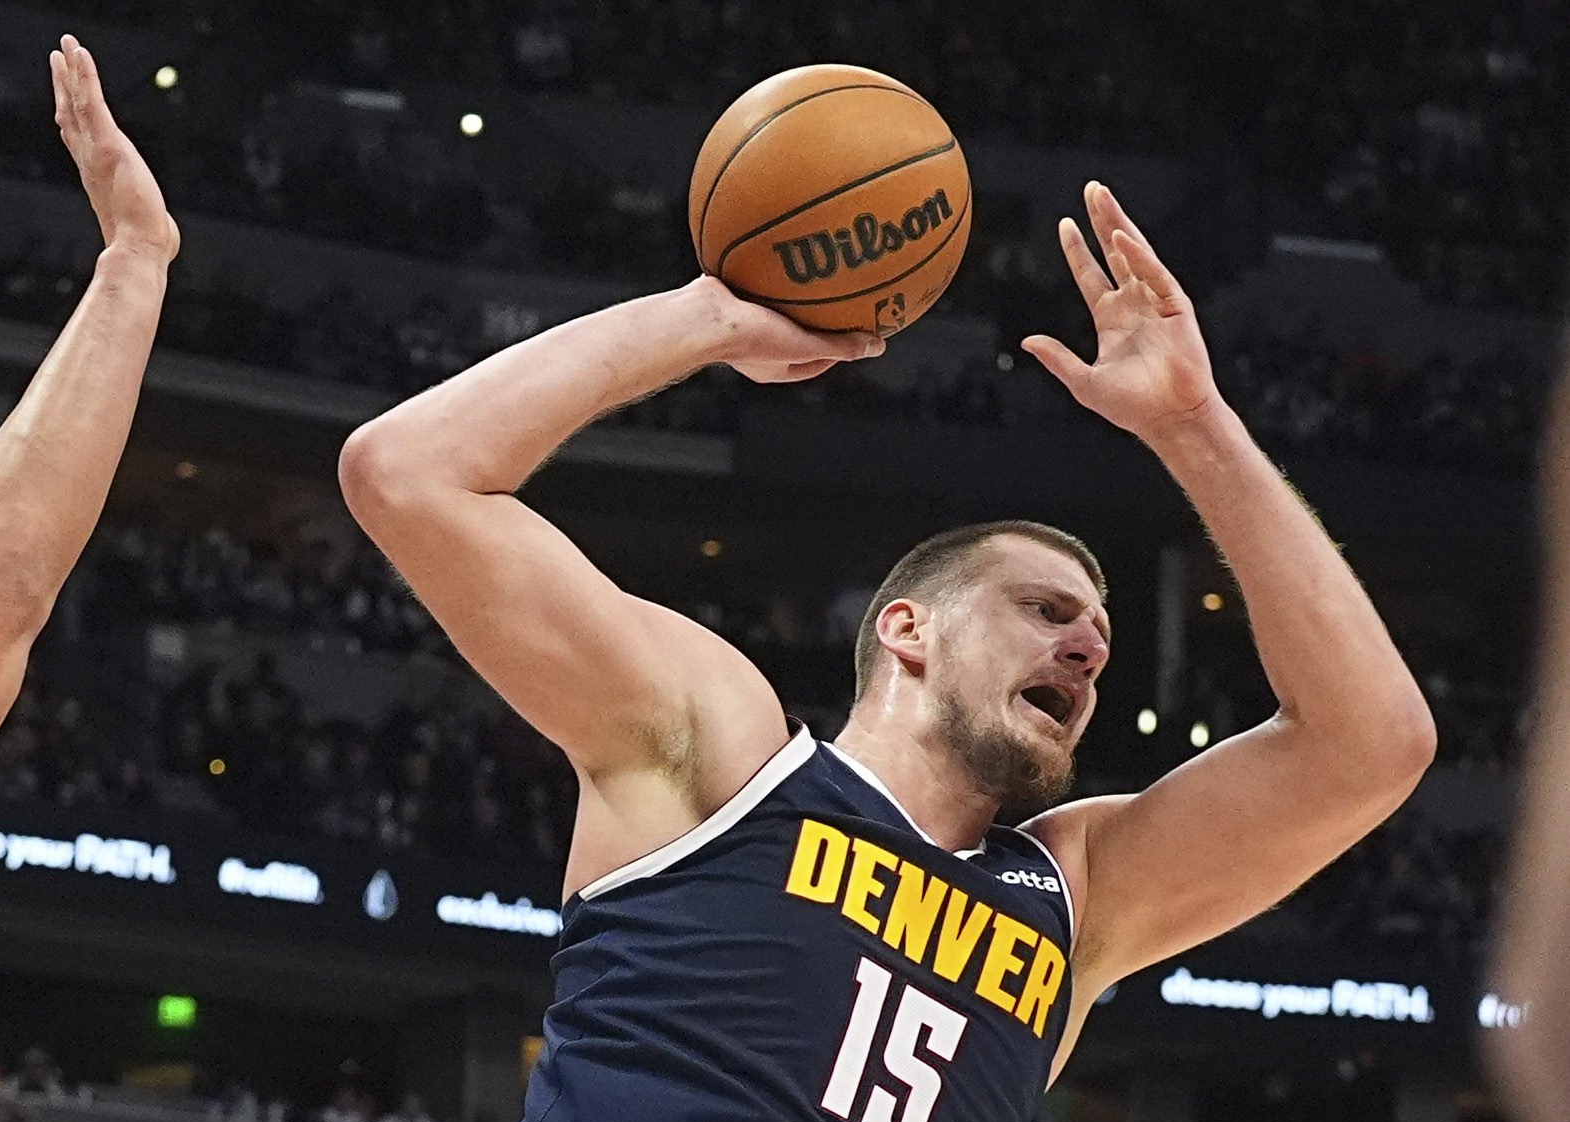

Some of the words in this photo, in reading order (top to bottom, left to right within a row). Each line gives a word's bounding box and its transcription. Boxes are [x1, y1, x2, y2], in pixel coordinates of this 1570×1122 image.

[772, 188, 953, 285] Wilson
[786, 819, 1066, 1039] DENVER
[996, 869, 1061, 893] otta
